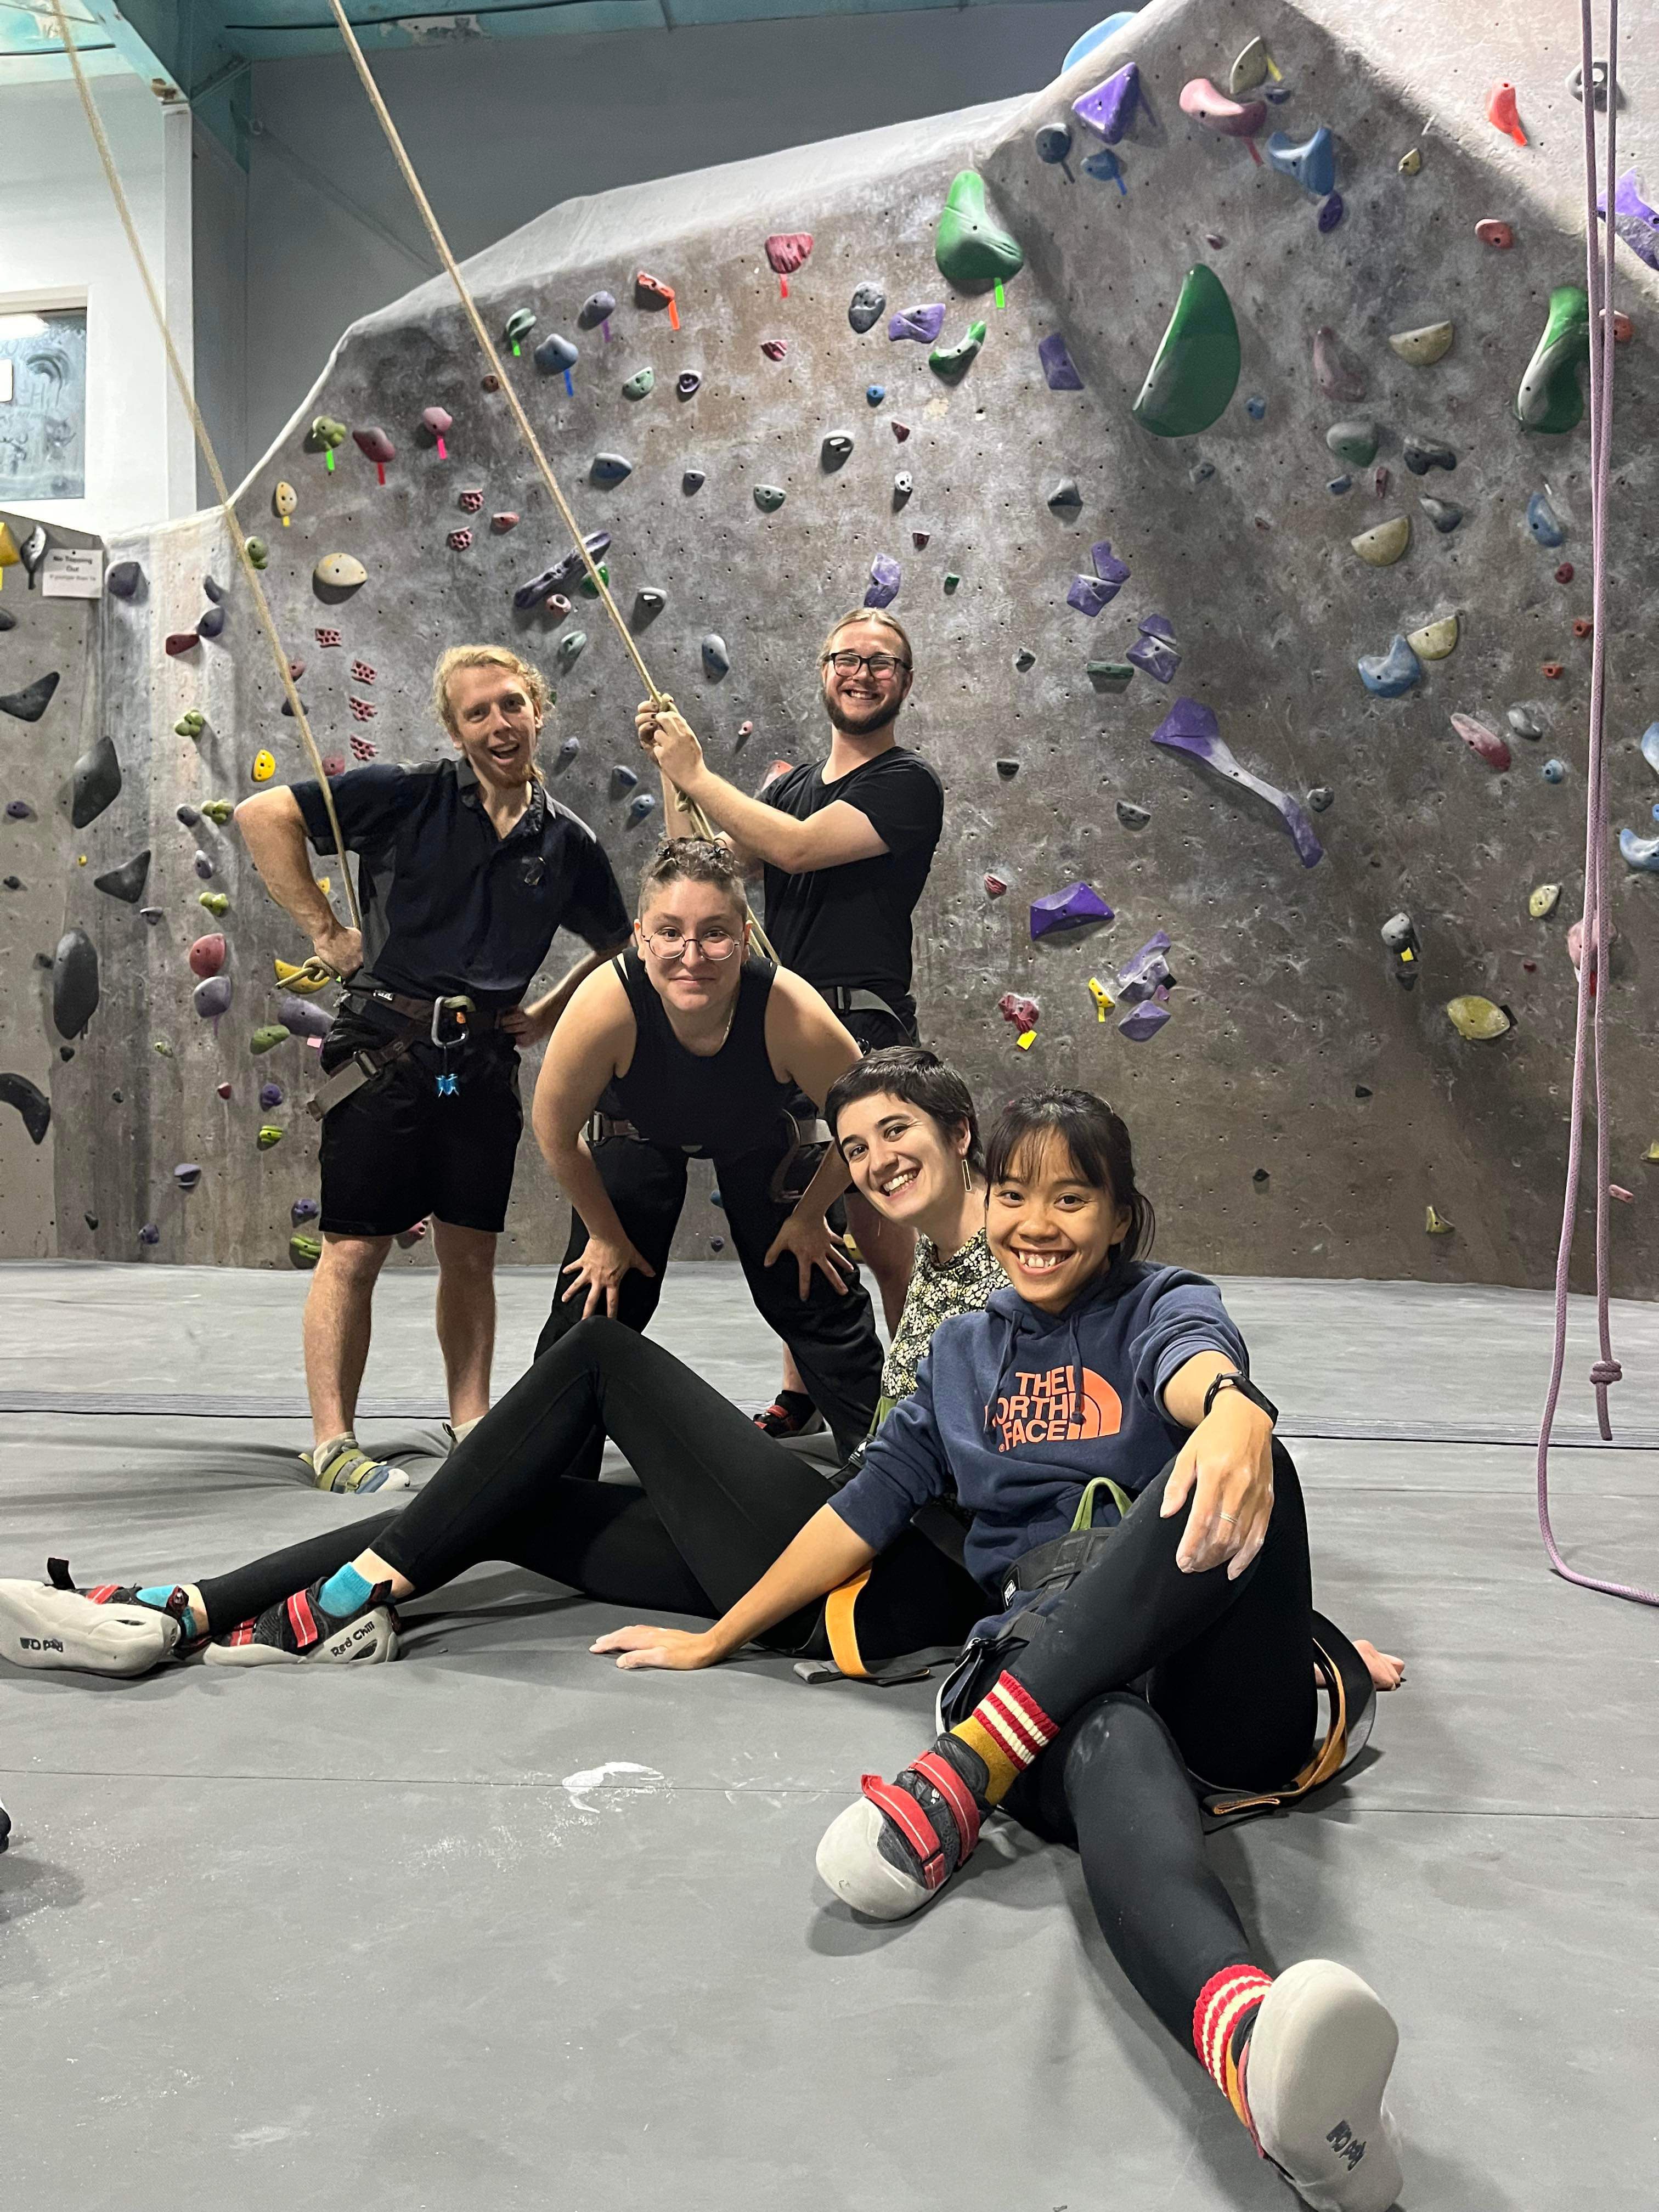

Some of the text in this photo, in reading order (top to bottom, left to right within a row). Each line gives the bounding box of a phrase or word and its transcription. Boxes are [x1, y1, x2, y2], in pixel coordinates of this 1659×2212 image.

[1015, 1367, 1067, 1397] THE
[1002, 1420, 1068, 1451] FACE
[330, 1637, 353, 1657] Red
